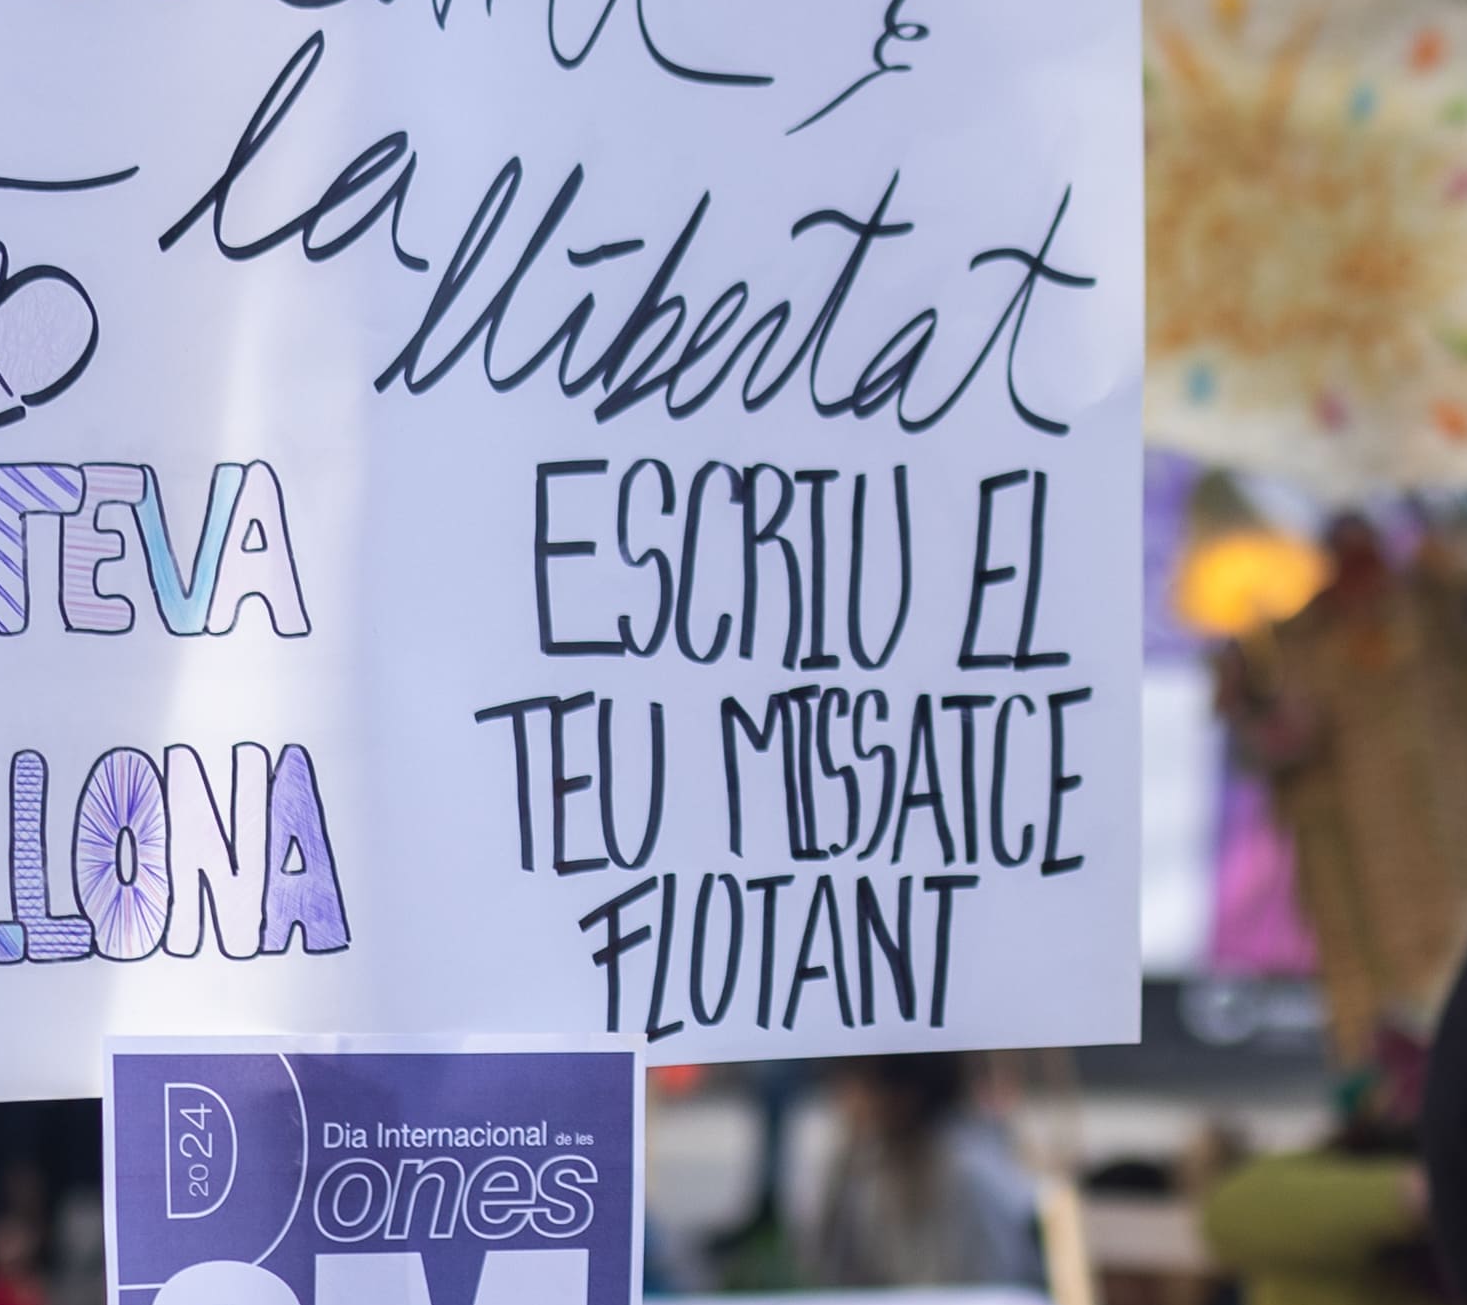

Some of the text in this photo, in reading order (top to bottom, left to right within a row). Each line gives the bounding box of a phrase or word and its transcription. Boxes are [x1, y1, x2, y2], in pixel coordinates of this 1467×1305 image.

[158, 29, 429, 264] la
[374, 156, 1096, 436] llibertat
[535, 458, 1071, 671] ESCRIU EL
[474, 690, 666, 878] TEU
[578, 872, 980, 1043] FLOTANT
[179, 1102, 213, 1197] 2024
[323, 1120, 595, 1149] Dia Internacional de les
